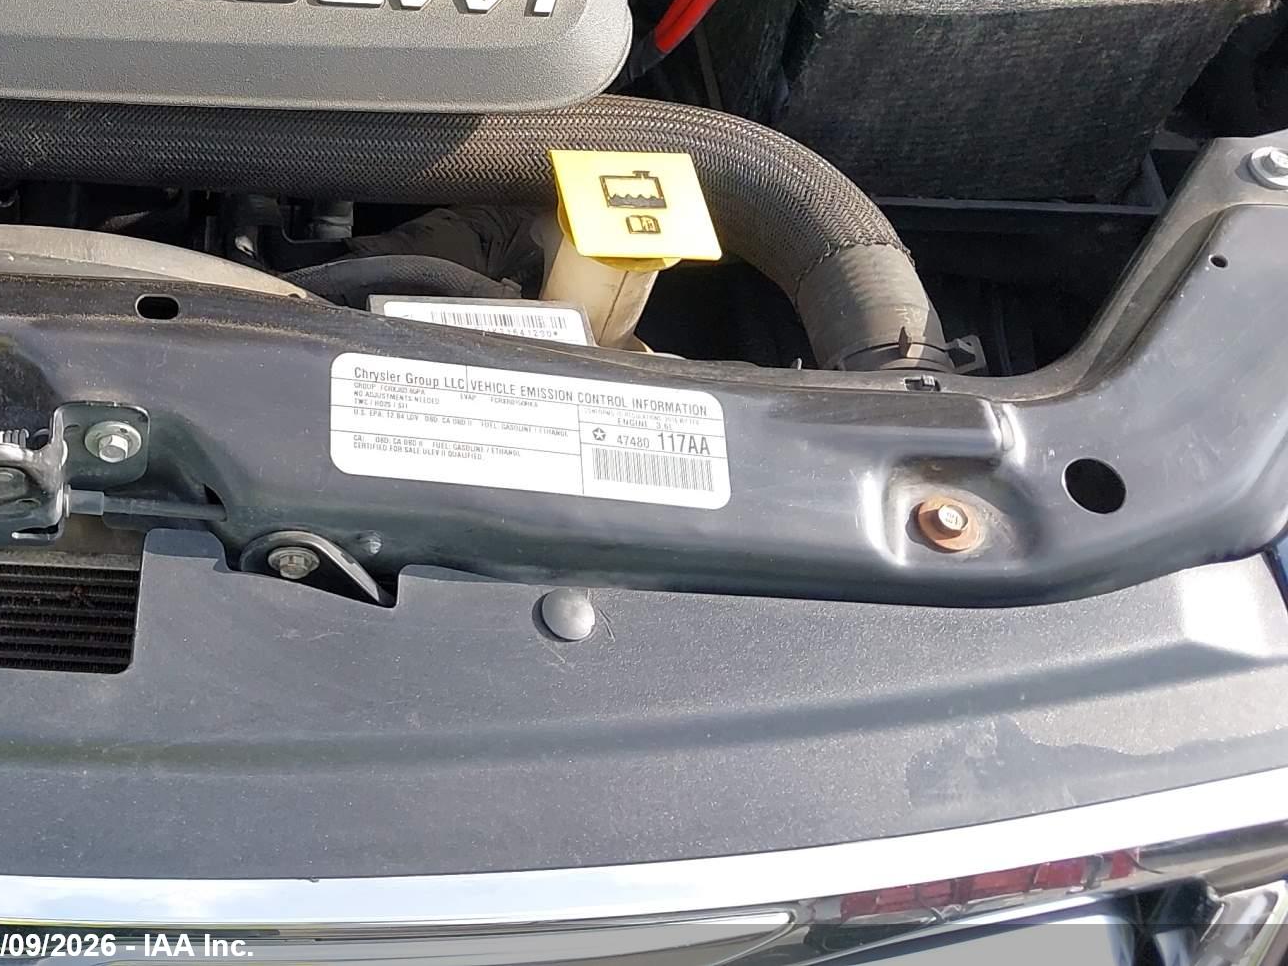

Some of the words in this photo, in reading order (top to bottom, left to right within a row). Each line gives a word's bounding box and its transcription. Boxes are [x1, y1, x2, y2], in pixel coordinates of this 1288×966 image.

[354, 366, 401, 383] Chrysler
[405, 372, 440, 390] Group
[444, 376, 465, 390] LLC
[470, 379, 516, 396] VEHICLE
[520, 385, 573, 402] EMISSION
[577, 391, 628, 408] CONTROL
[631, 396, 708, 417] INFORMATION
[616, 434, 650, 449] 47480
[657, 432, 711, 456] 117AA
